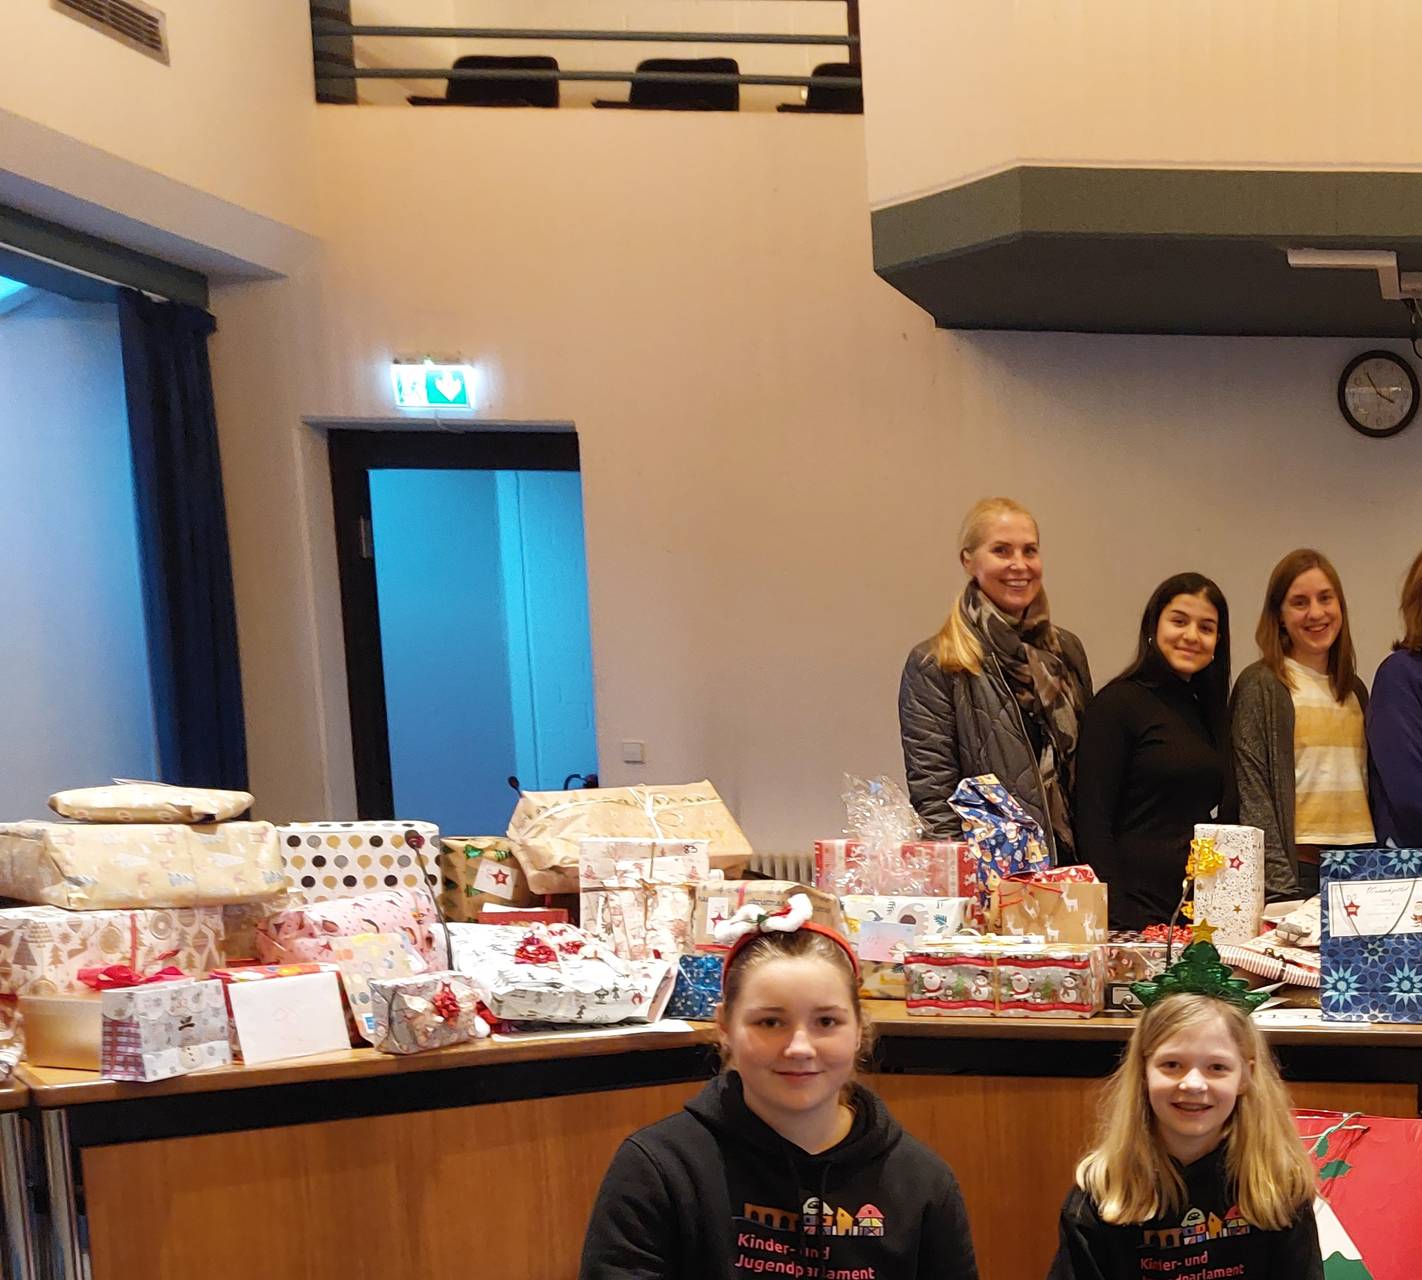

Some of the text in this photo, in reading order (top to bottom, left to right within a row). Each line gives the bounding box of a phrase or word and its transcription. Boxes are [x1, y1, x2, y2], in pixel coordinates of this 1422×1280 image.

[738, 1233, 796, 1255] Kinder-
[734, 1254, 876, 1280] Jugendparament
[1185, 1250, 1208, 1267] und
